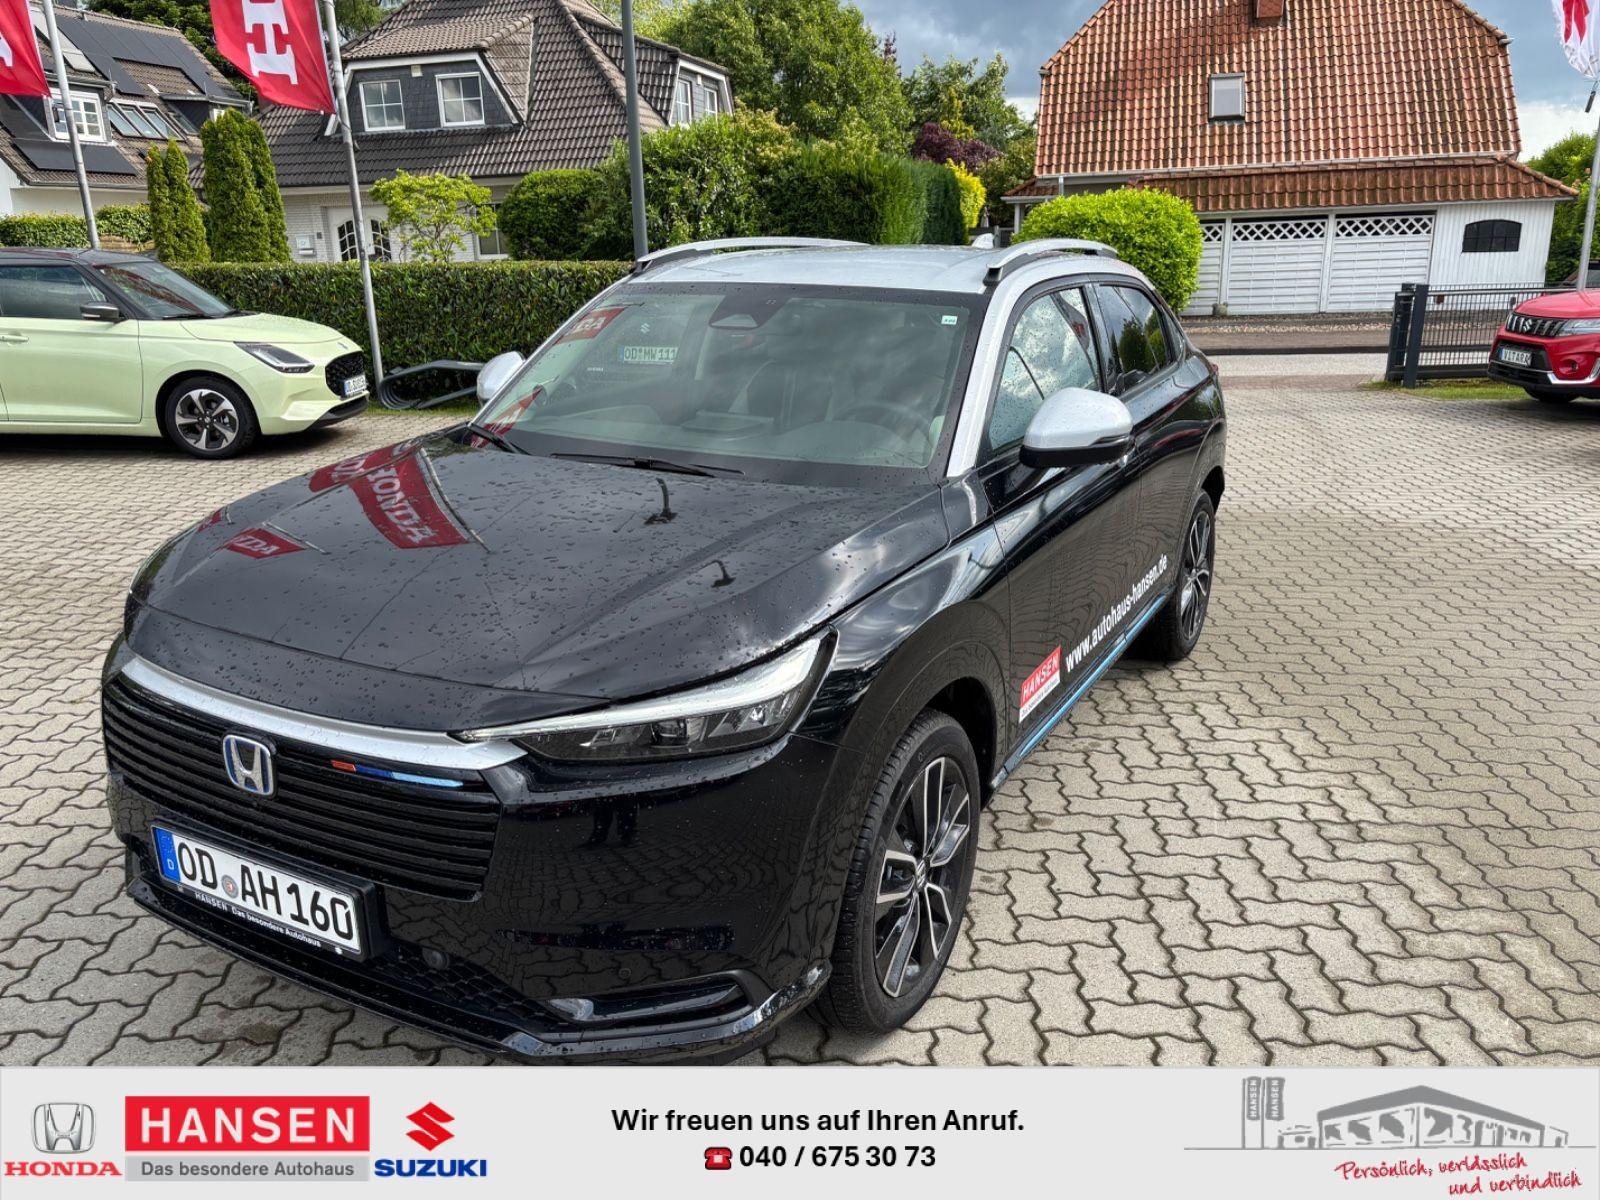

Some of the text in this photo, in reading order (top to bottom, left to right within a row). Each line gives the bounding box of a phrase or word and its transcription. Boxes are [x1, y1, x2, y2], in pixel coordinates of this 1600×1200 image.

[1065, 553, 1168, 673] www.autohaus-hansen.de
[1022, 652, 1060, 704] HANSEN
[177, 841, 218, 890] OD
[194, 891, 322, 948] HANSEN Das besondere Autohaus
